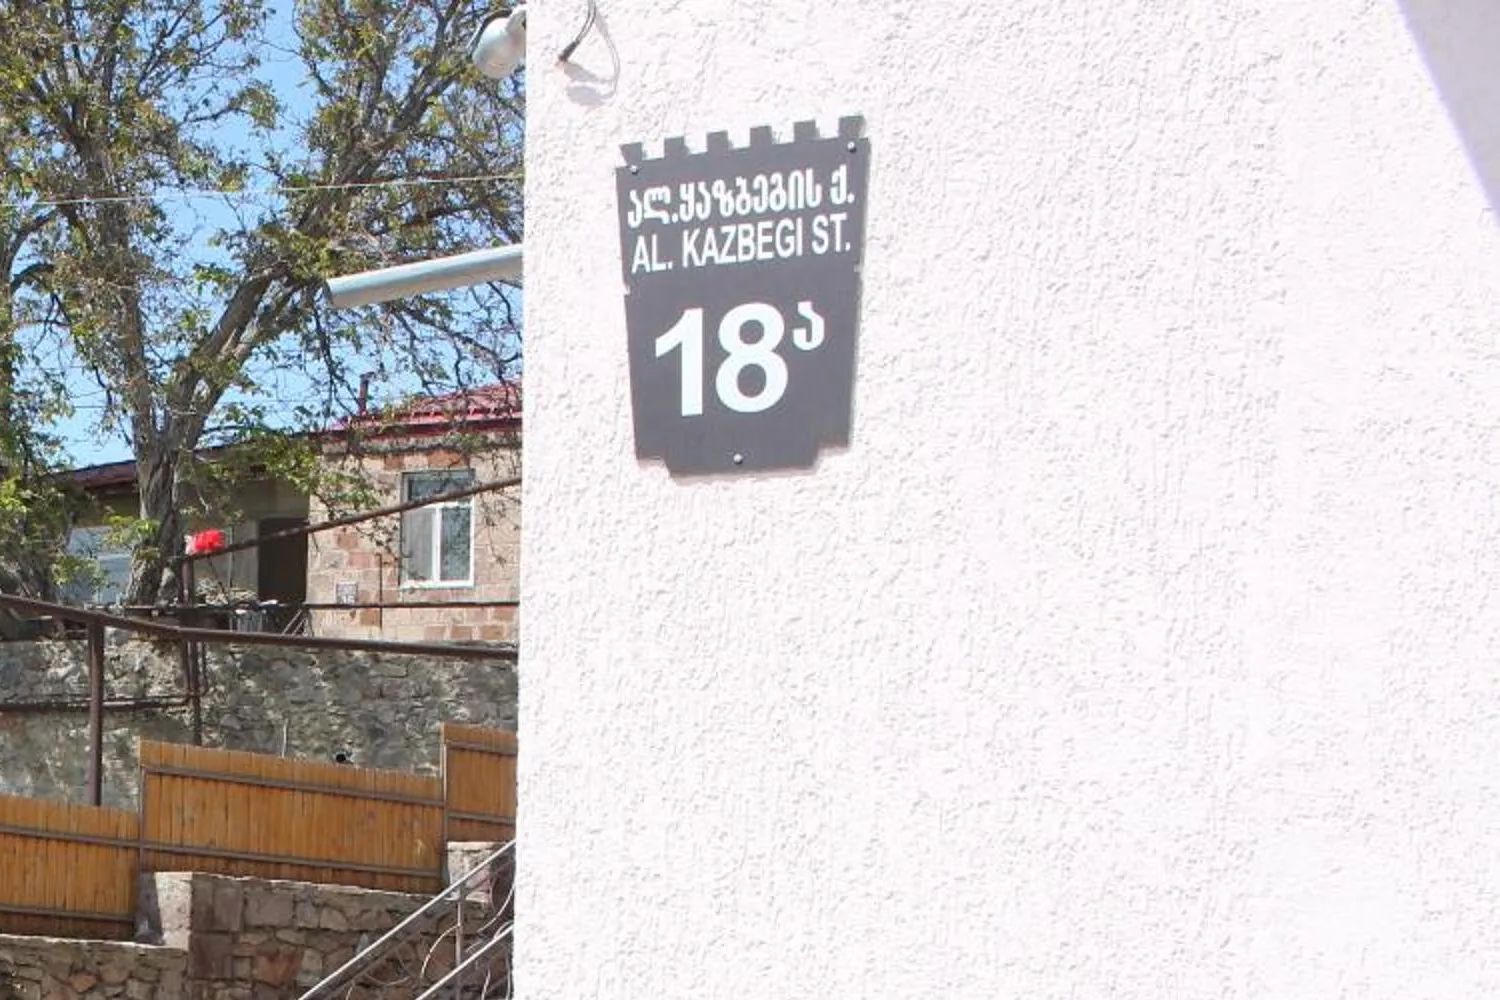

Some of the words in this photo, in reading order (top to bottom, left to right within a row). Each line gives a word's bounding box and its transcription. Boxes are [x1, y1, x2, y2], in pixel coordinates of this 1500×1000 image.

[830, 164, 855, 205] ქ.
[631, 233, 674, 275] AL.
[681, 217, 804, 269] KAZBEGI
[811, 212, 852, 256] ST.
